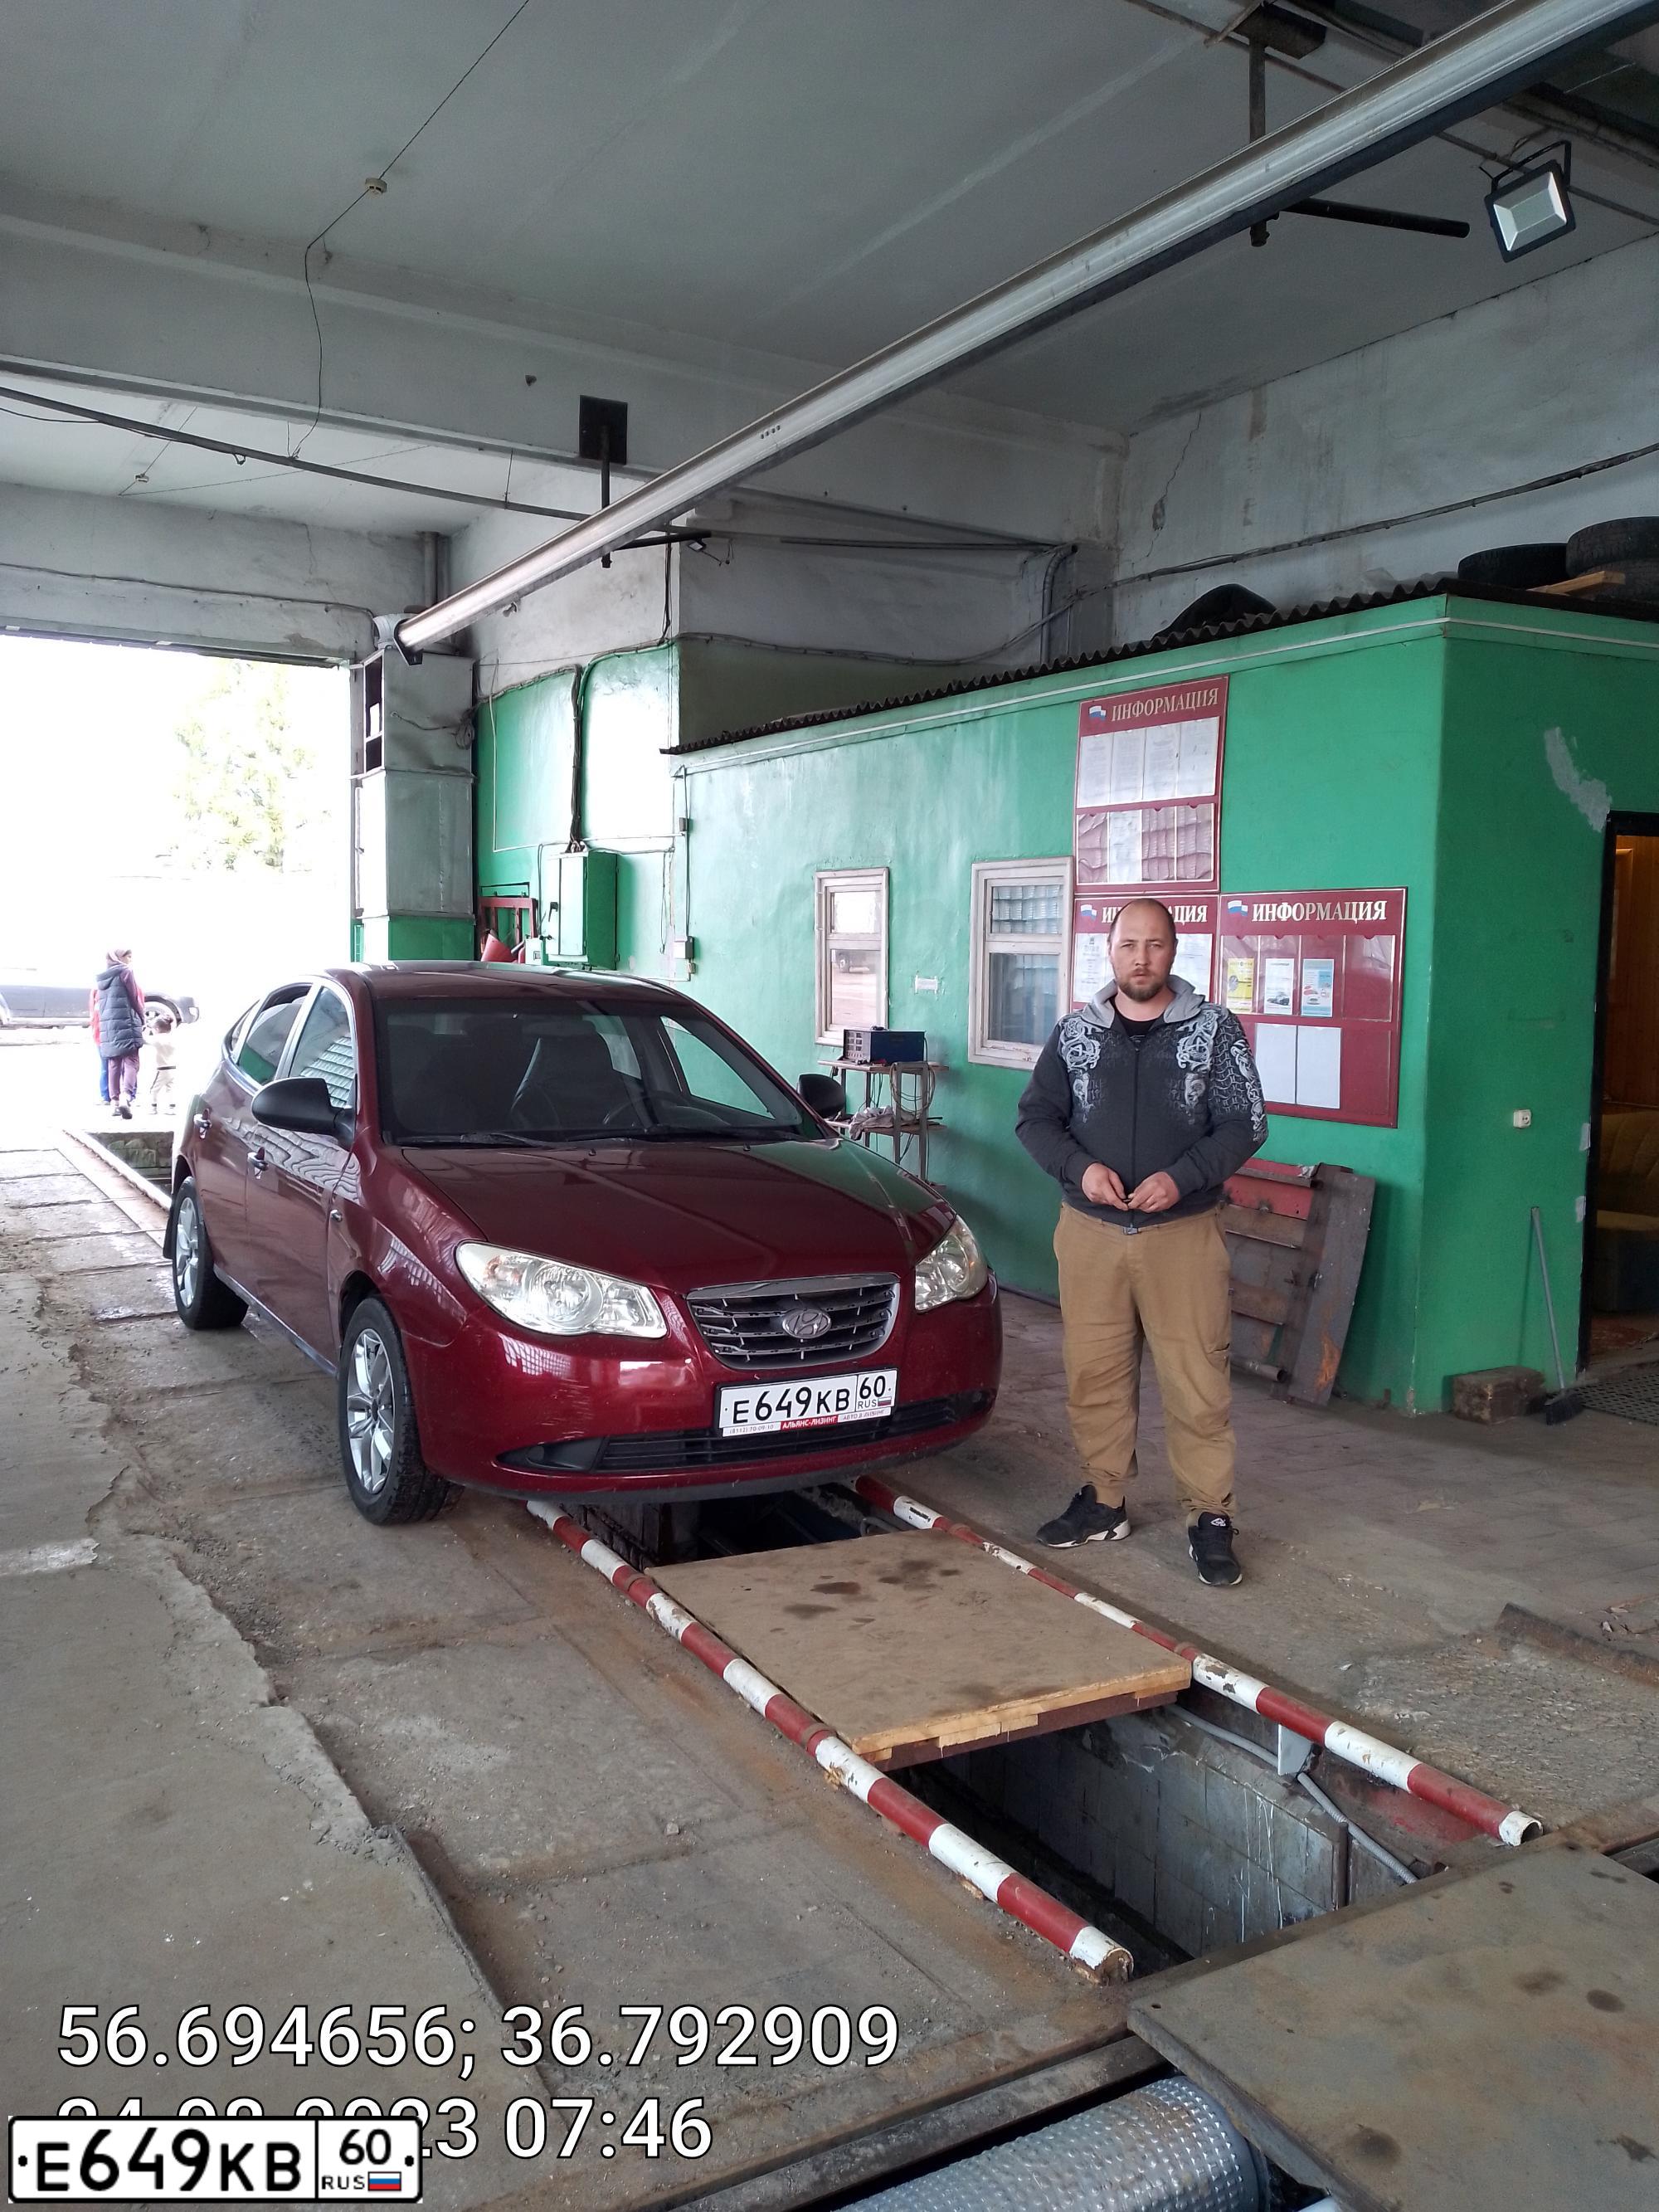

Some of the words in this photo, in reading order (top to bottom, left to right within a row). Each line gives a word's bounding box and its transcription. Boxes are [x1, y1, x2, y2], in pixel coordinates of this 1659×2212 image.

[1111, 688, 1219, 722] ИНФОРМАЦИЯ
[1251, 900, 1388, 924] ИНФОРМАЦИЯ
[859, 1375, 886, 1400] 60
[857, 1399, 877, 1410] RUS
